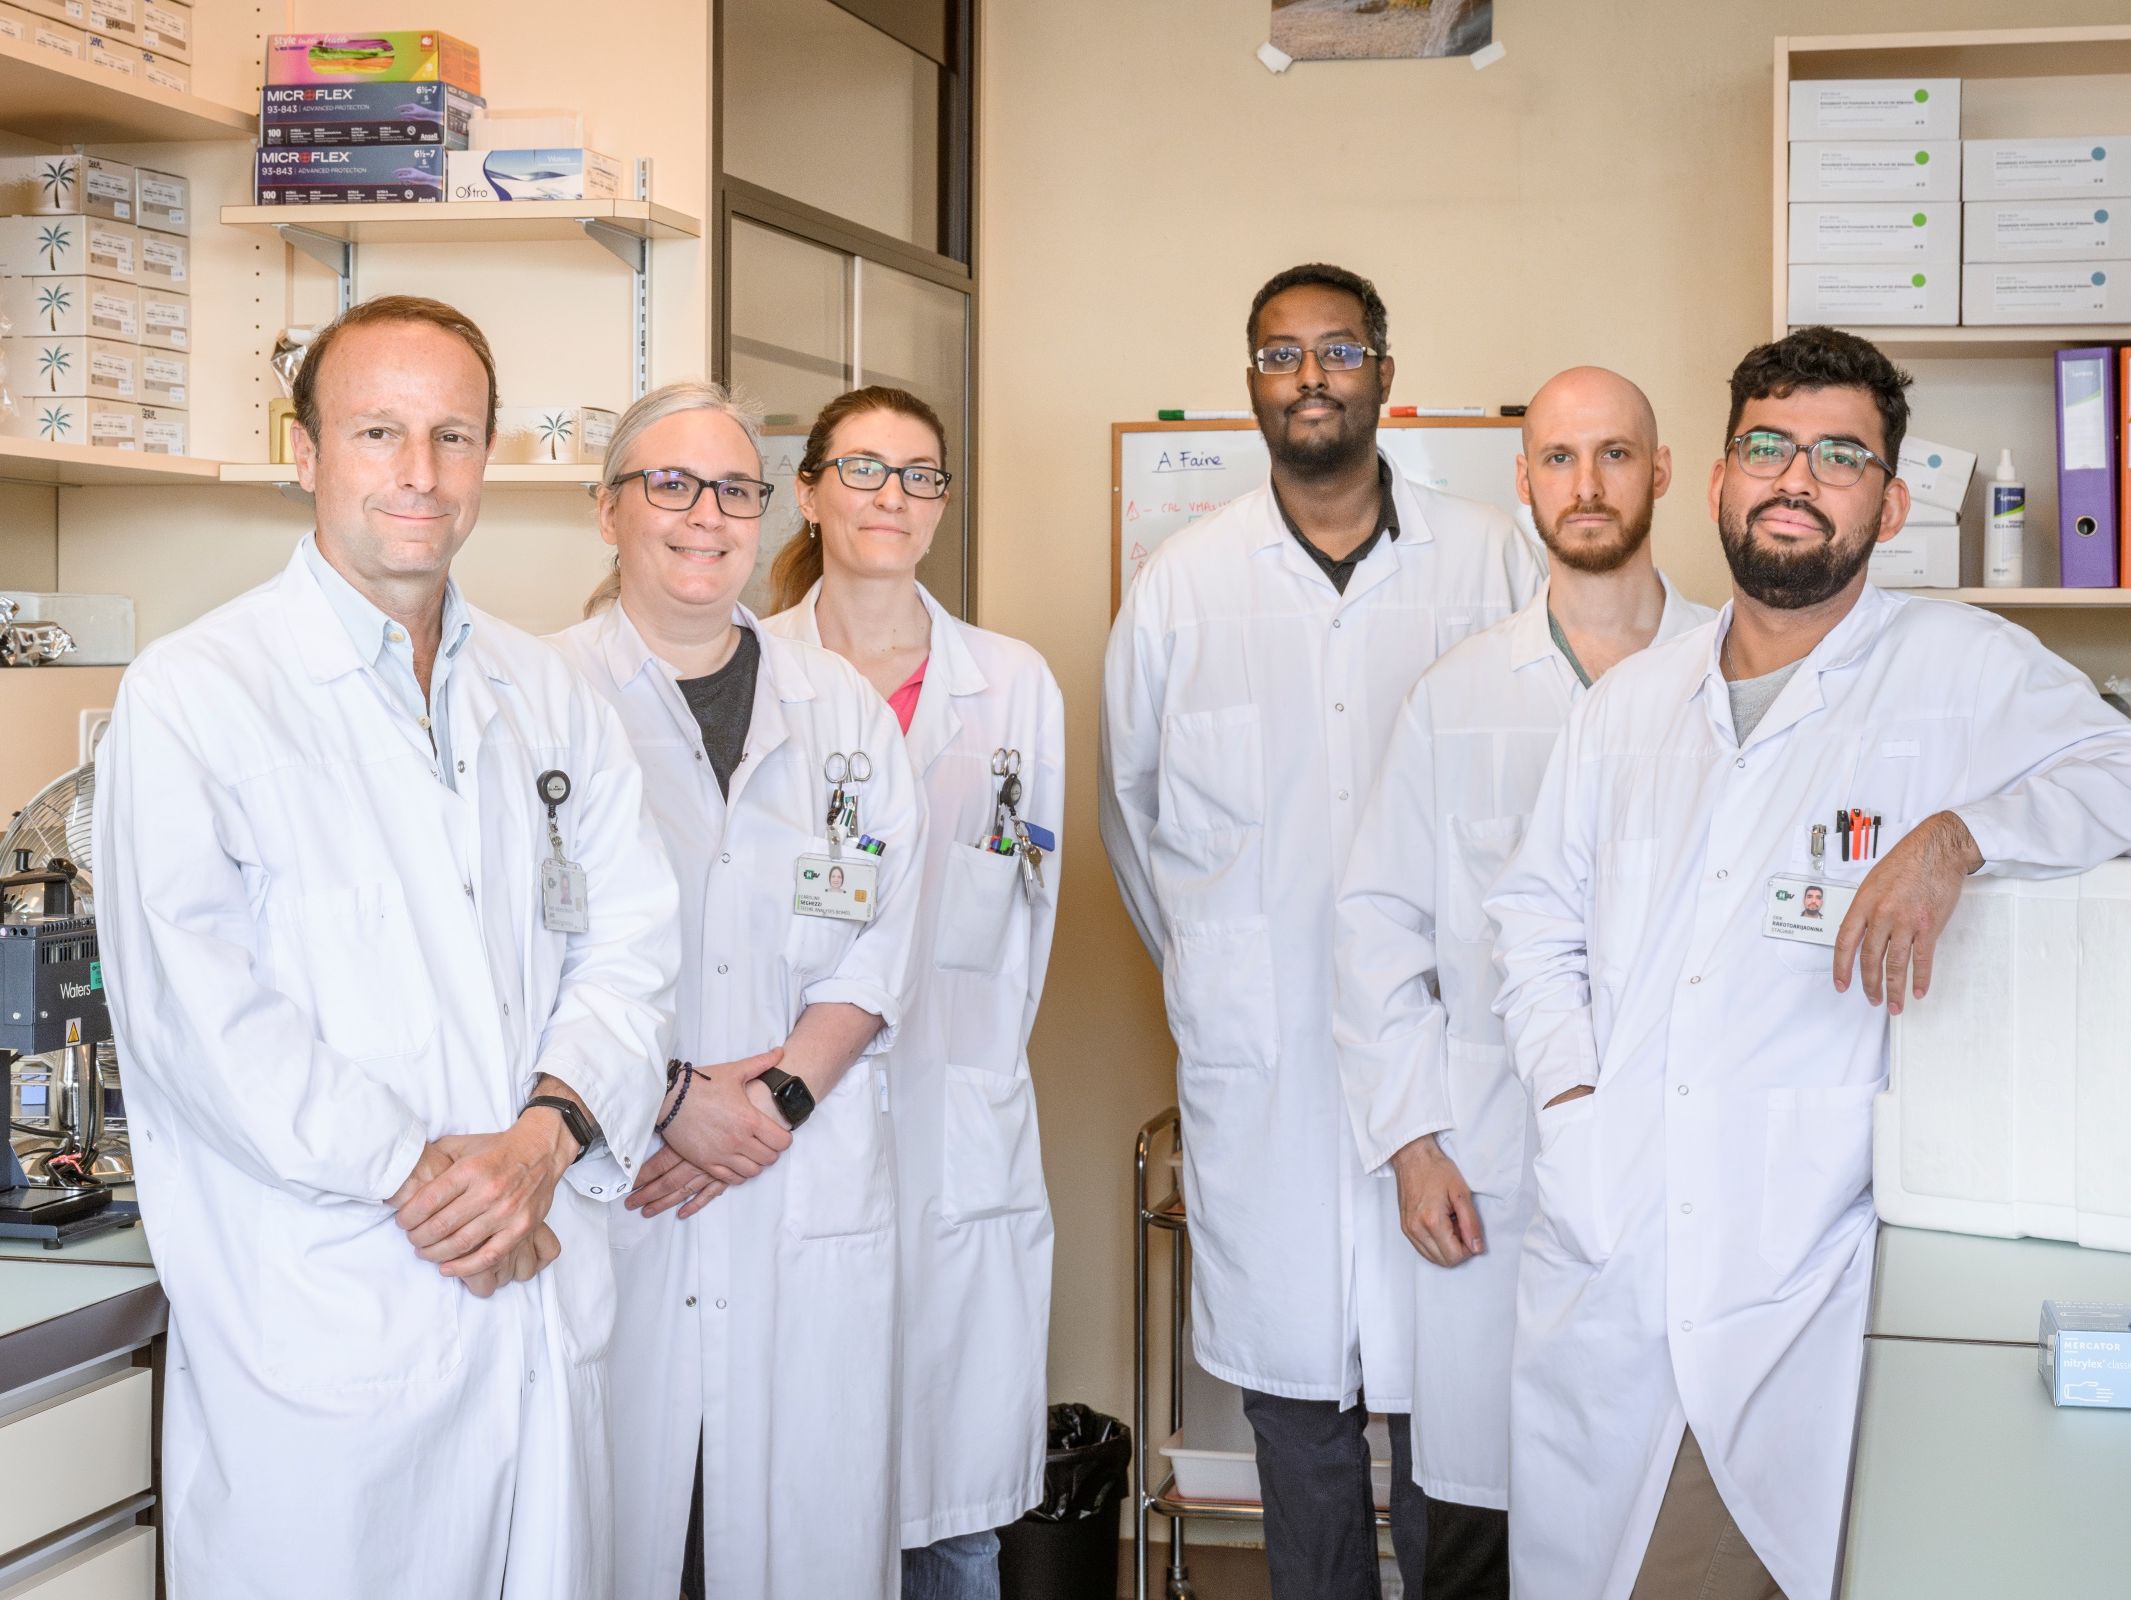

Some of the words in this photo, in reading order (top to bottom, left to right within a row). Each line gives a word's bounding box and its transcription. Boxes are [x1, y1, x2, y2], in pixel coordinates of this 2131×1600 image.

[267, 105, 298, 113] 93-843
[267, 129, 281, 137] 100
[262, 191, 276, 199] 100
[1157, 451, 1172, 472] A
[60, 982, 91, 999] Waters
[2064, 1342, 2120, 1352] MERCATOR
